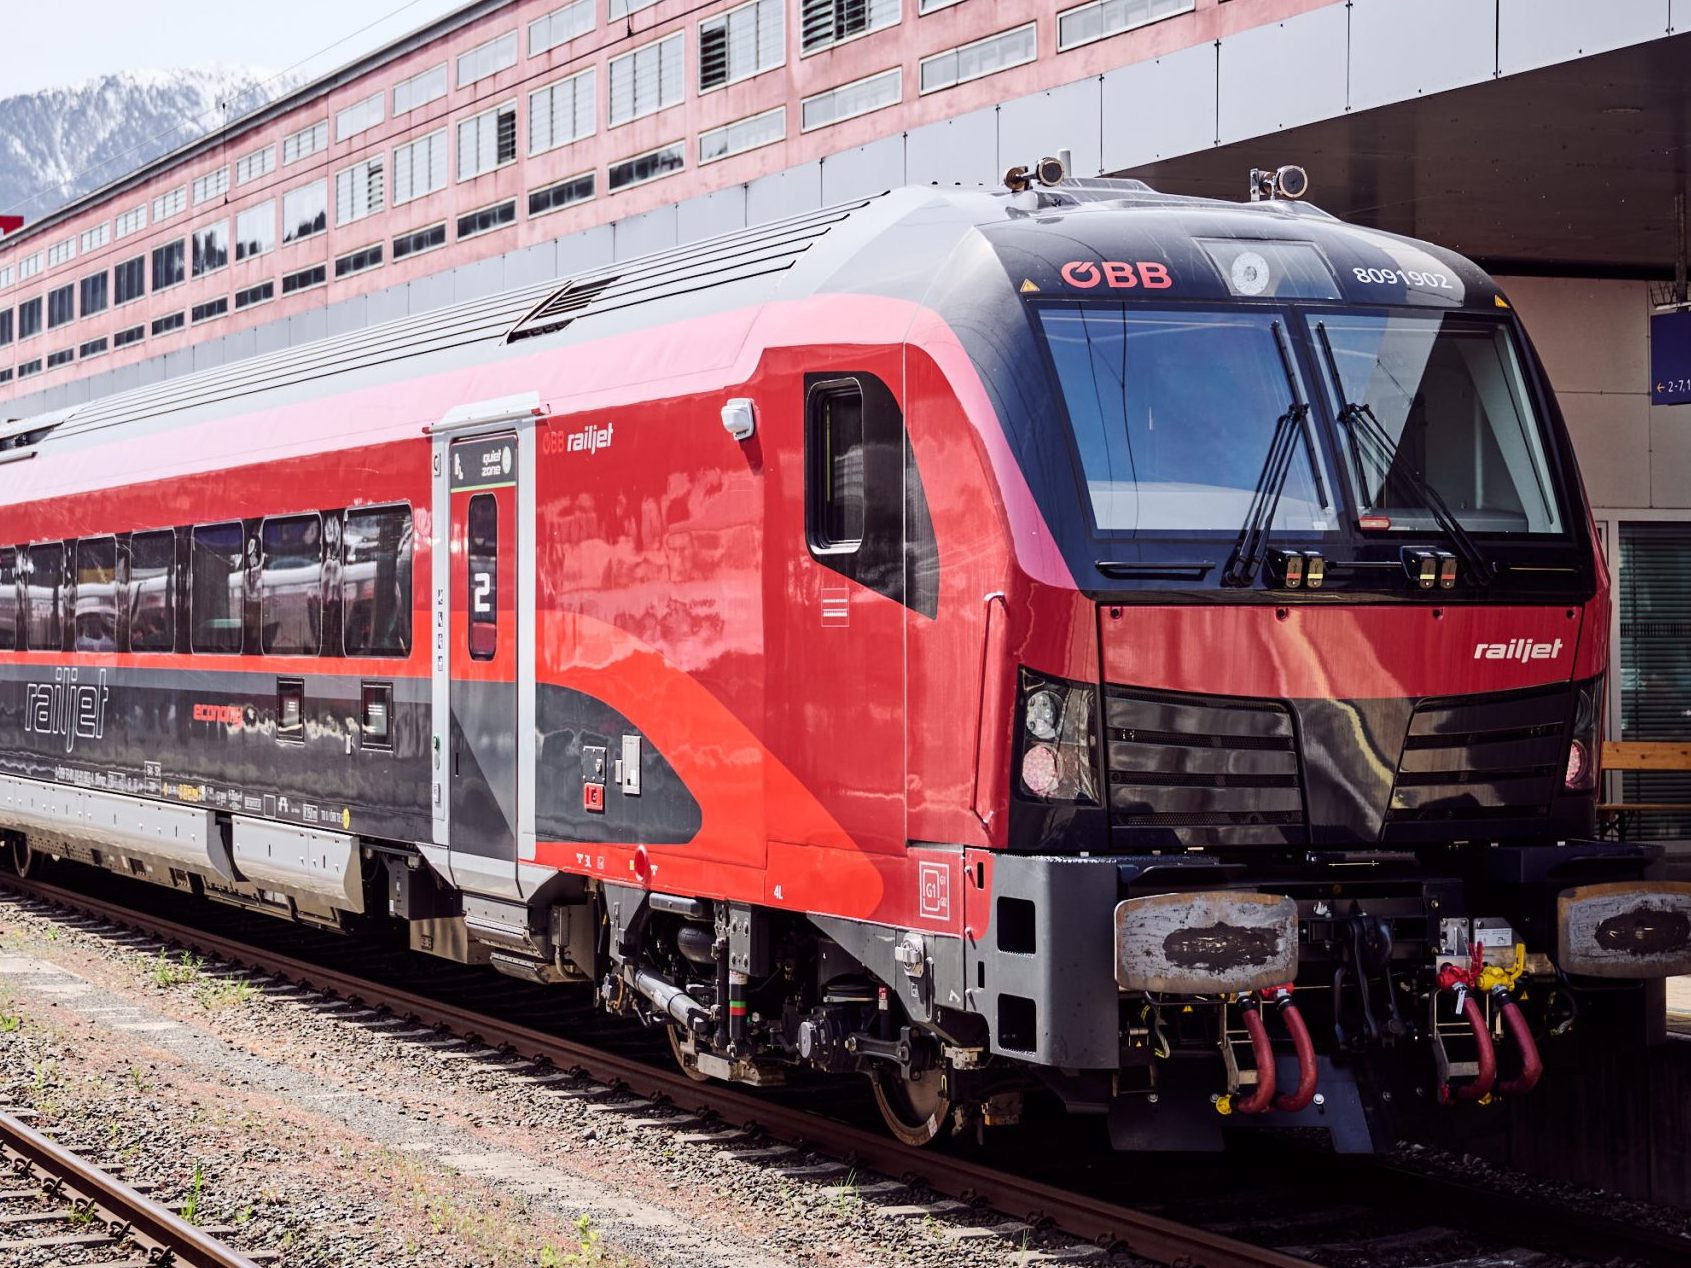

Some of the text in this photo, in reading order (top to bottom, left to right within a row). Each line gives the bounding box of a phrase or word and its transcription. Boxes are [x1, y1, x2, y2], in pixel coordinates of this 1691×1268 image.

[1061, 261, 1173, 289] ÖBB
[1352, 267, 1454, 289] 8091902
[567, 422, 614, 455] railjet
[482, 448, 501, 465] quiet
[481, 465, 501, 477] zone
[474, 572, 491, 612] 2
[1474, 638, 1564, 664] railjet
[25, 667, 109, 754] railjet
[193, 703, 243, 729] economy
[773, 884, 784, 900] 4L
[926, 883, 936, 898] G1
